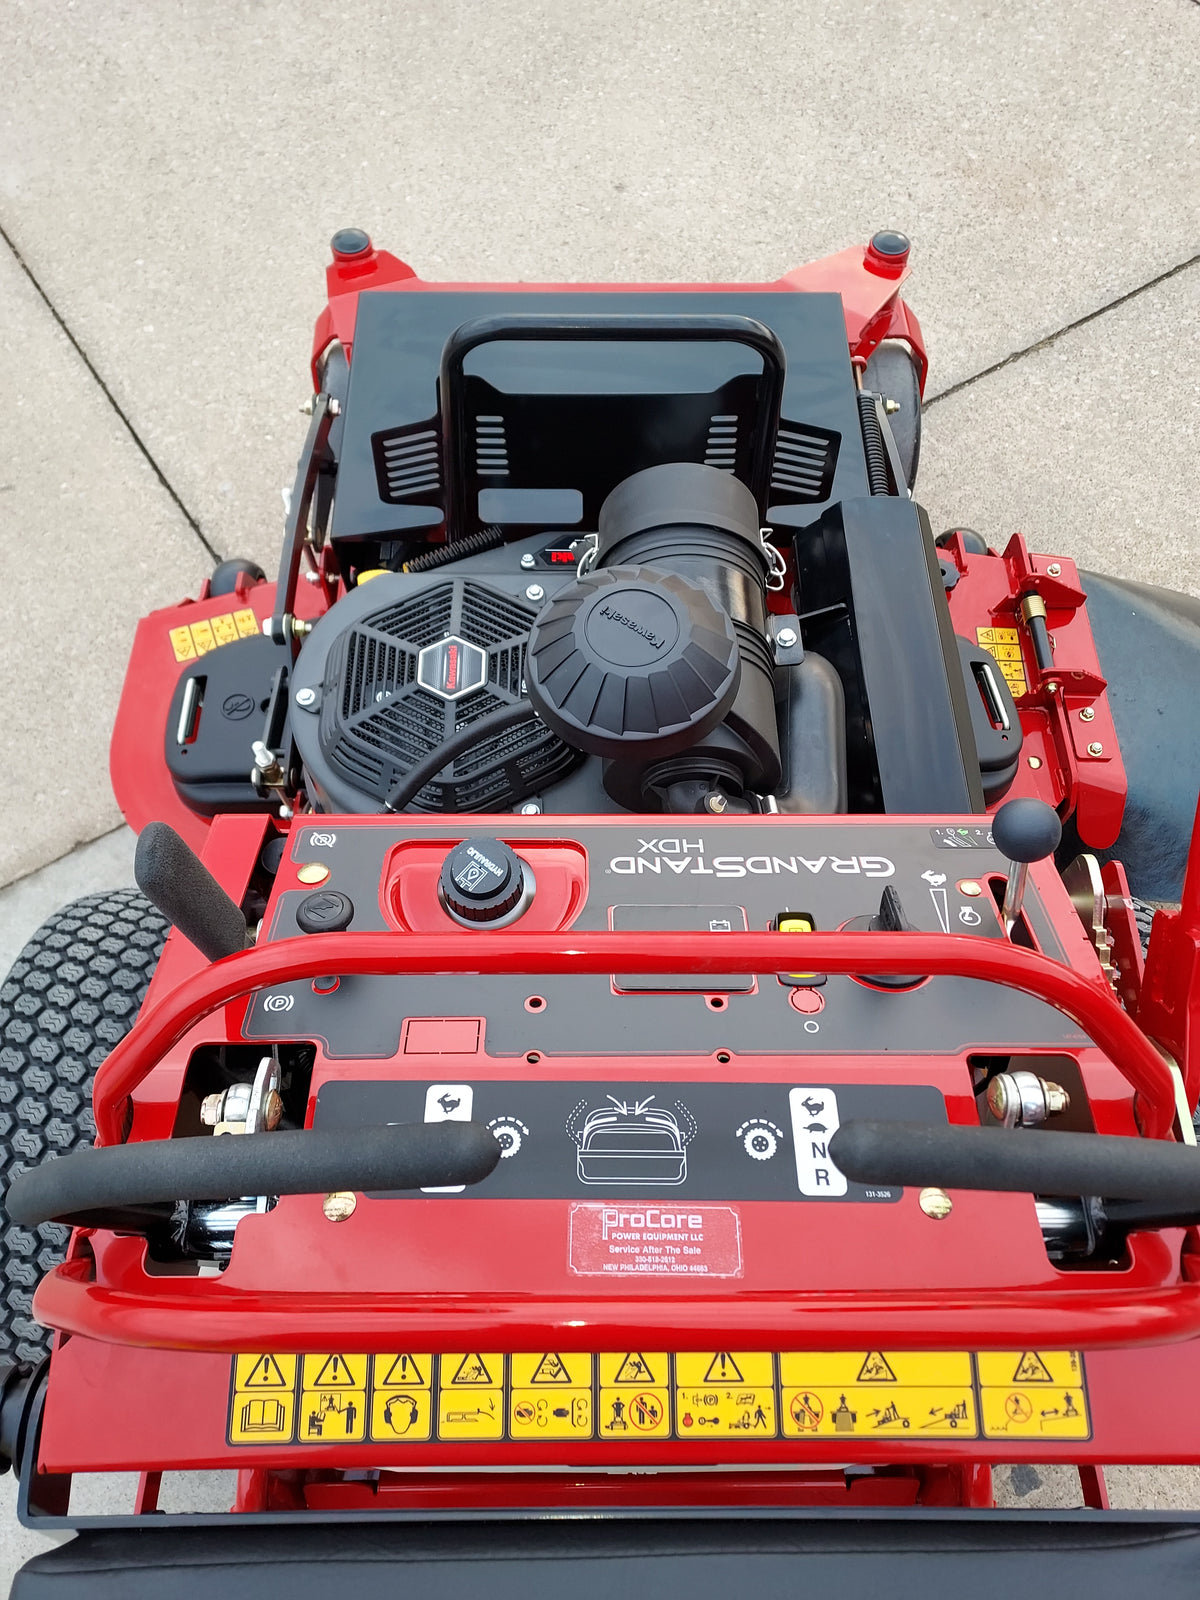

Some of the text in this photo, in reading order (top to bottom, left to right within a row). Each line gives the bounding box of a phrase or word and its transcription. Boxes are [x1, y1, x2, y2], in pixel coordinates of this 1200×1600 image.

[599, 606, 666, 651] Kawasaki
[446, 645, 458, 690] Kawasaki
[637, 838, 704, 854] HDX
[466, 846, 504, 877] HYDRAULIC
[811, 1142, 827, 1159] N
[815, 1168, 831, 1186] R
[611, 1233, 641, 1241] POWER
[642, 1233, 689, 1241] EQUIPMENT
[609, 1245, 702, 1255] Service After The Sale
[603, 1263, 619, 1271] NEW
[619, 1263, 670, 1272] PHILADELPHIA,
[671, 1264, 688, 1272] OHIO
